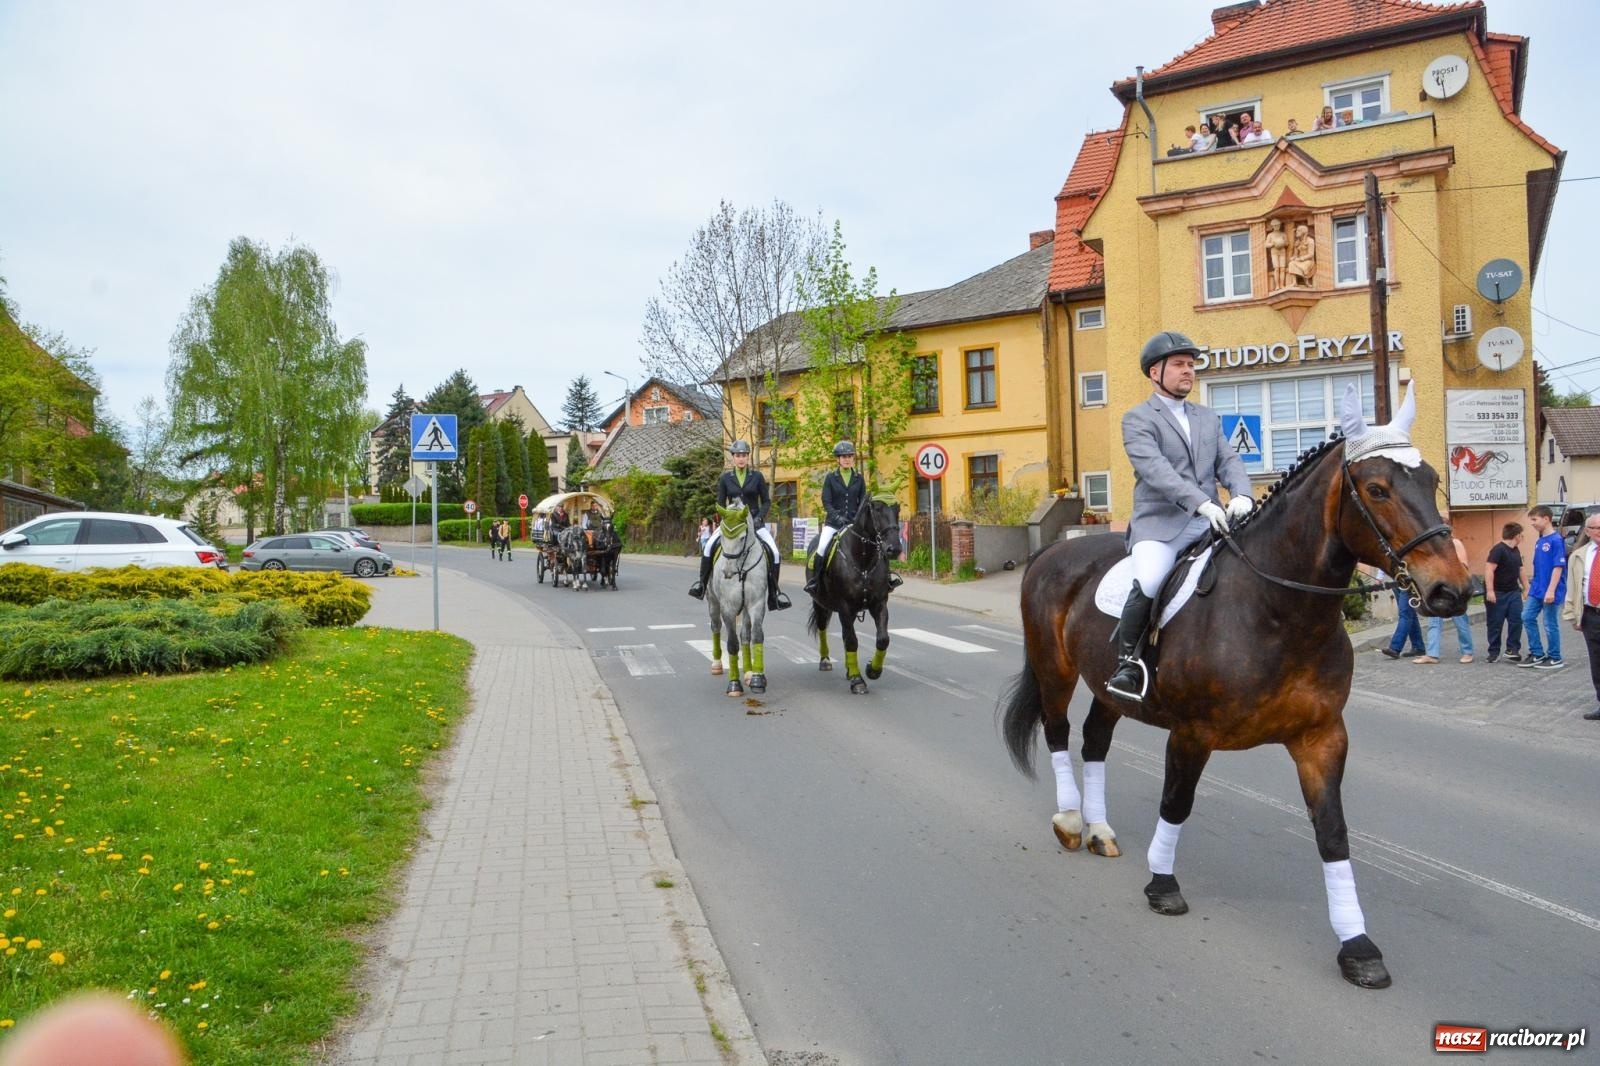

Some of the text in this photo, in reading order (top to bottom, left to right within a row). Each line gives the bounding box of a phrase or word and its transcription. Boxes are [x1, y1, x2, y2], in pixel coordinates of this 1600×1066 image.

[1485, 270, 1514, 279] TV-SAT
[1487, 339, 1514, 348] TV-SAT
[1194, 342, 1290, 370] STUDIO
[1477, 412, 1490, 420] 533
[1491, 412, 1505, 420] 354
[1506, 412, 1519, 420] 333
[920, 453, 944, 469] 40
[1452, 480, 1485, 489] STUDIO
[1469, 492, 1508, 501] SOLARIUM
